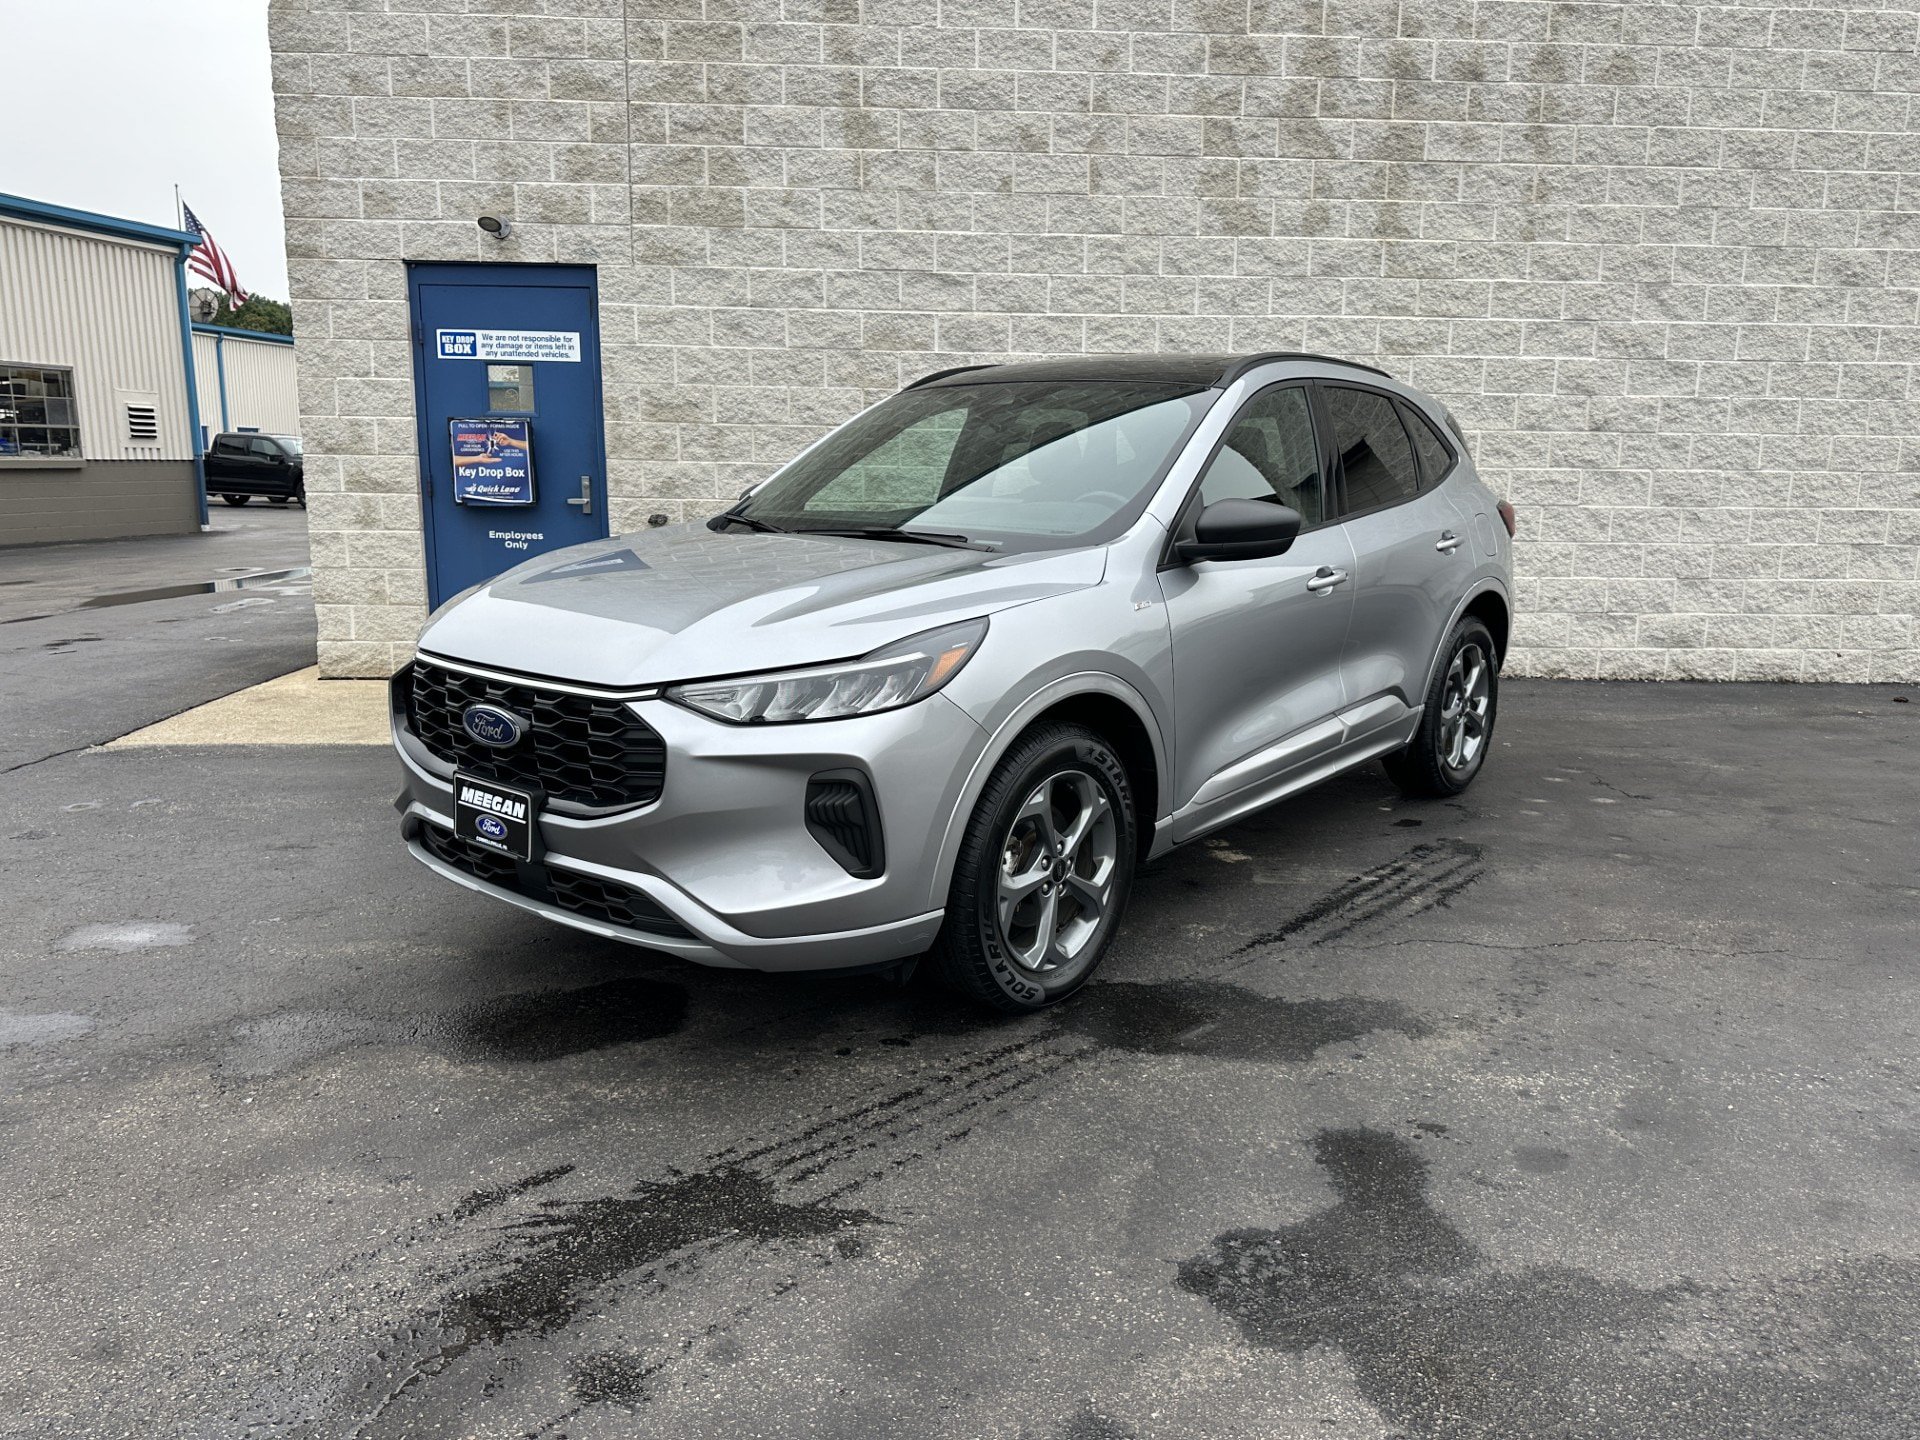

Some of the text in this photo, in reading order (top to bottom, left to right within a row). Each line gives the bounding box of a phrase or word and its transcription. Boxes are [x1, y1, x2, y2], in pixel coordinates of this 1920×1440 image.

[441, 335, 475, 344] KEY DROP
[481, 333, 493, 341] We
[508, 334, 520, 342] not
[521, 334, 561, 344] responsible
[563, 335, 574, 343] for
[444, 343, 473, 354] BOX
[481, 343, 494, 351] any
[495, 341, 524, 351] damage
[534, 342, 554, 350] items
[485, 349, 572, 359] any unattended vehicles.
[458, 466, 525, 480] Key Drop Box
[477, 484, 500, 493] Quick
[500, 485, 521, 493] Lane
[488, 530, 544, 541] Employees
[504, 540, 529, 550] Only
[472, 711, 504, 740] Ford
[460, 785, 526, 819] MEEGAN
[482, 818, 501, 835] Ford
